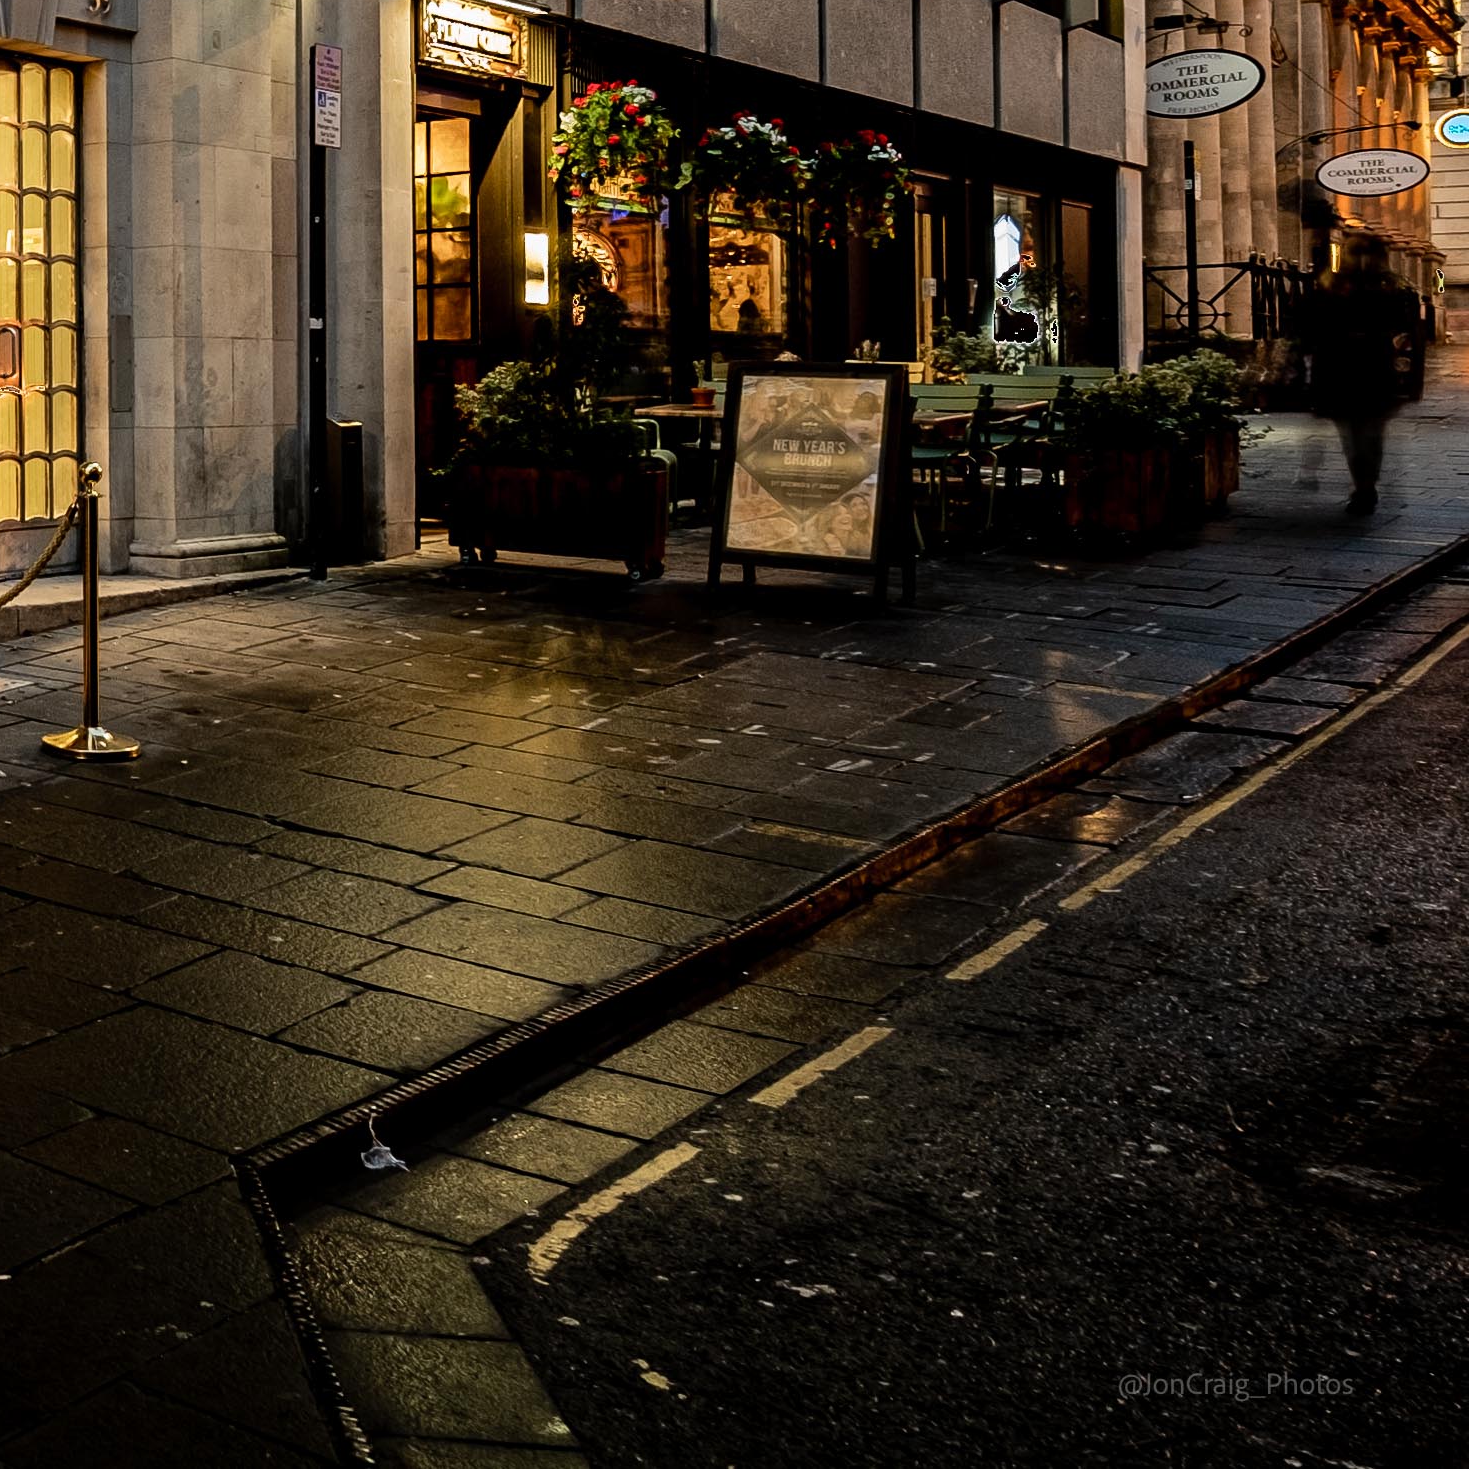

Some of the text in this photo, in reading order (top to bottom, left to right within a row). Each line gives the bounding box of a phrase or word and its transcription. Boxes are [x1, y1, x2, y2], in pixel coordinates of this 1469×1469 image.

[1176, 63, 1209, 77] THE
[1162, 86, 1220, 103] ROOMS
[1359, 158, 1386, 168] THE
[1326, 165, 1418, 178] COMMERCIAL
[1346, 175, 1395, 186] ROOMS
[773, 439, 846, 455] NEW YEAR'S
[783, 452, 833, 468] BRUNCH
